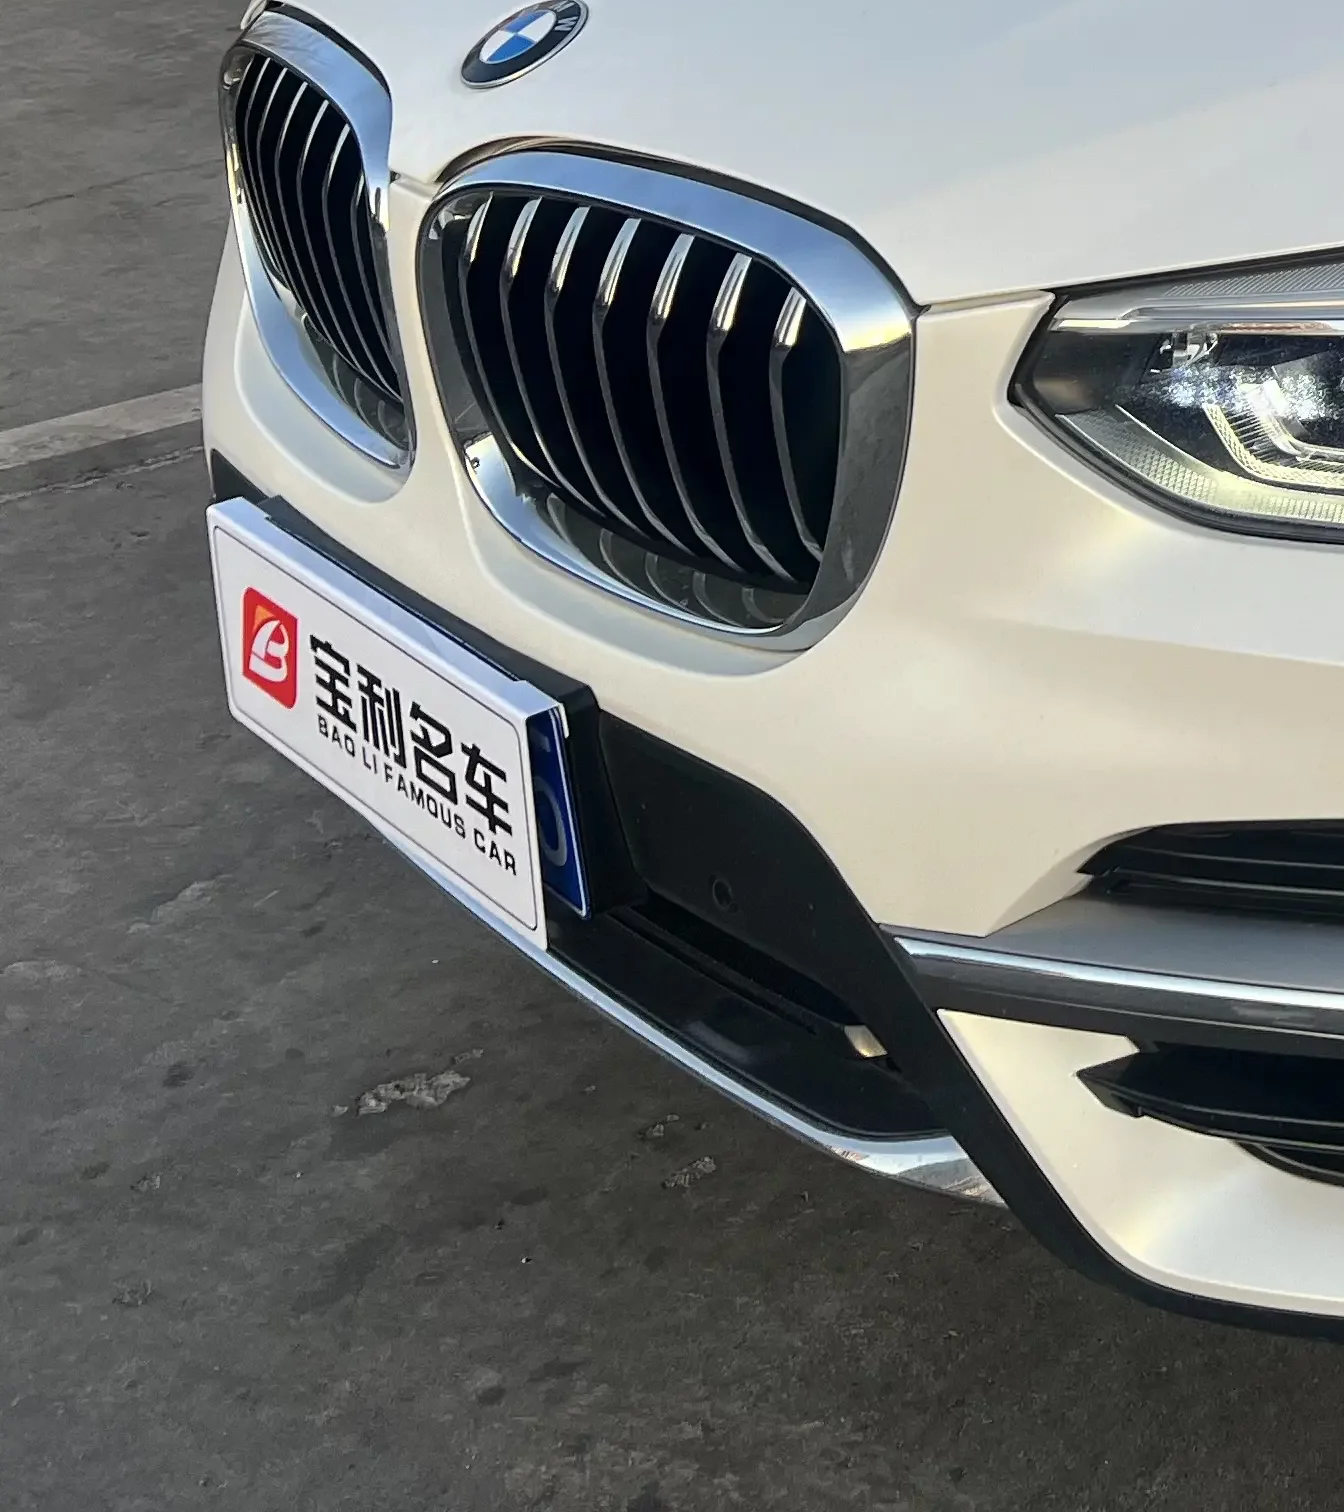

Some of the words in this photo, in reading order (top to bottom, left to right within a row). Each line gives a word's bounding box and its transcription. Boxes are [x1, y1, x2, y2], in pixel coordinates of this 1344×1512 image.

[310, 634, 513, 836] 宝利名车
[317, 714, 355, 758] BAO
[362, 746, 378, 775] LI
[384, 763, 466, 839] FAMOUS
[474, 828, 517, 876] CAR
